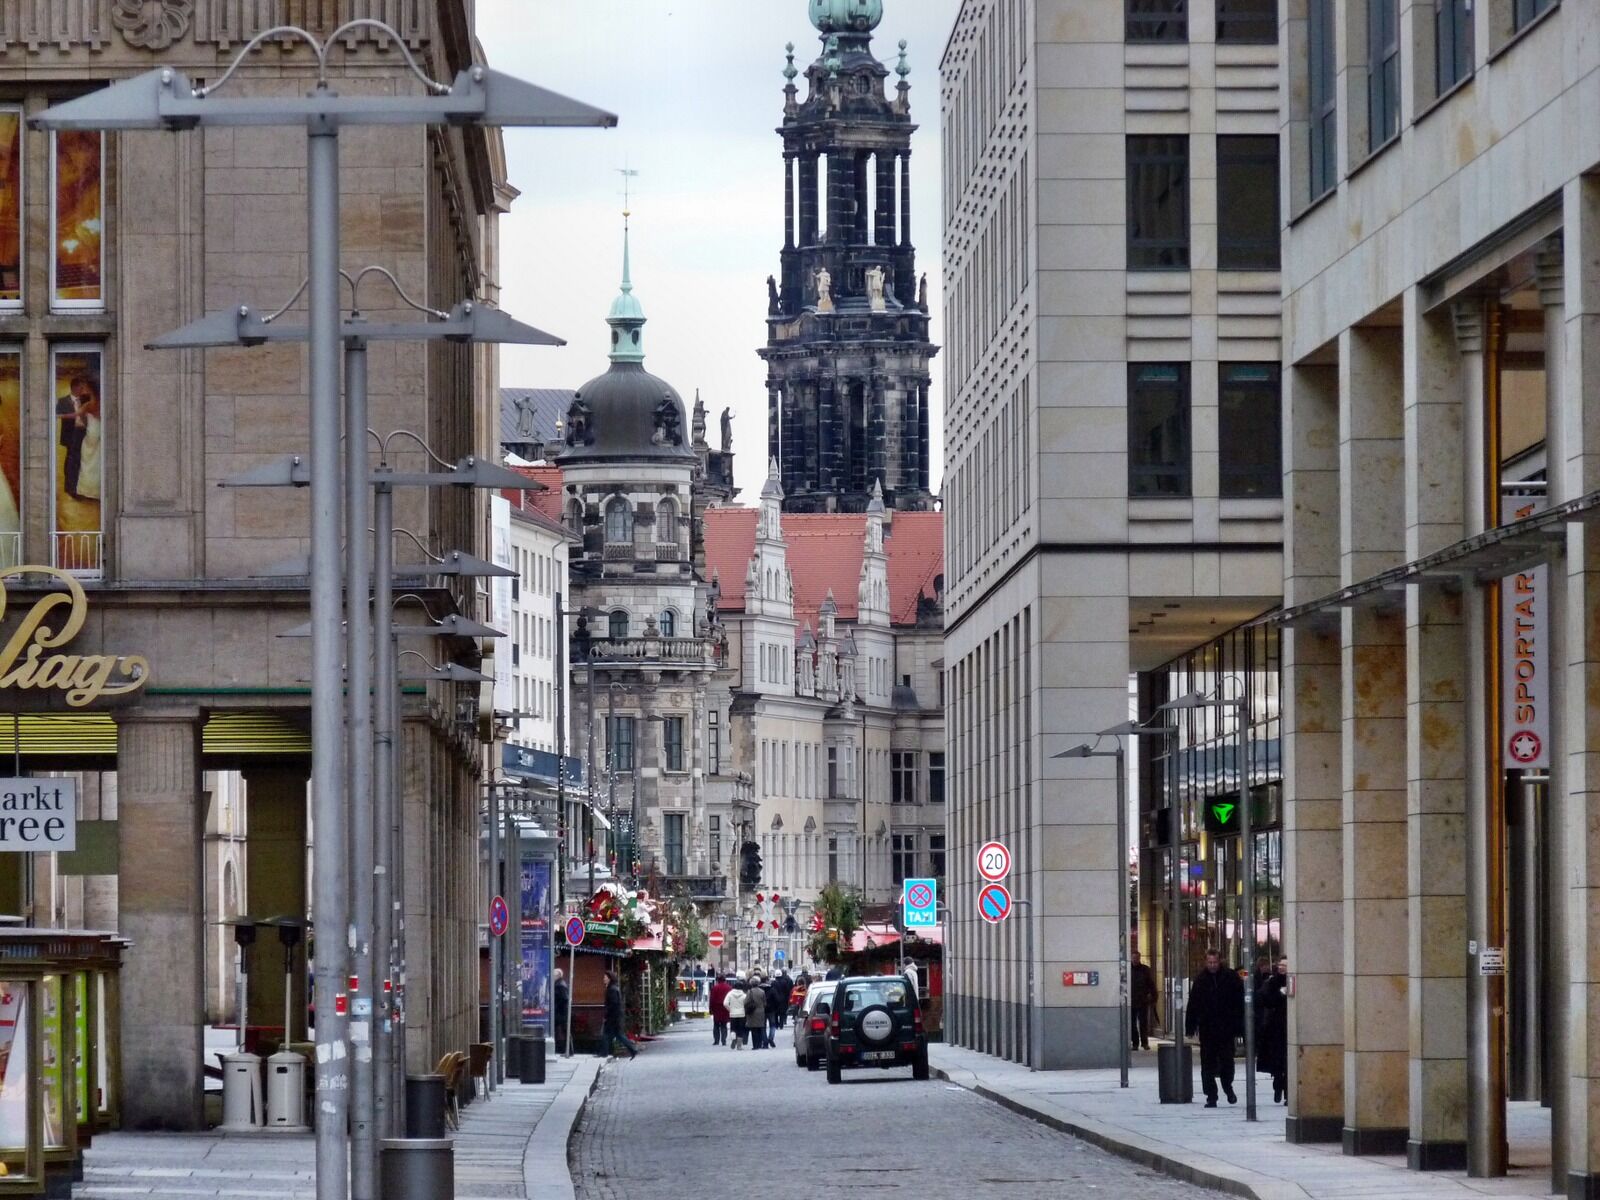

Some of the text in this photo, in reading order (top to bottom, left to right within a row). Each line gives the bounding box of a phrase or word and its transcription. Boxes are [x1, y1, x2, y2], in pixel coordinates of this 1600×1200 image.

[1514, 502, 1535, 725] SPORTARA
[0, 816, 65, 842] ree
[986, 853, 1003, 870] 20
[908, 911, 933, 922] TAXI
